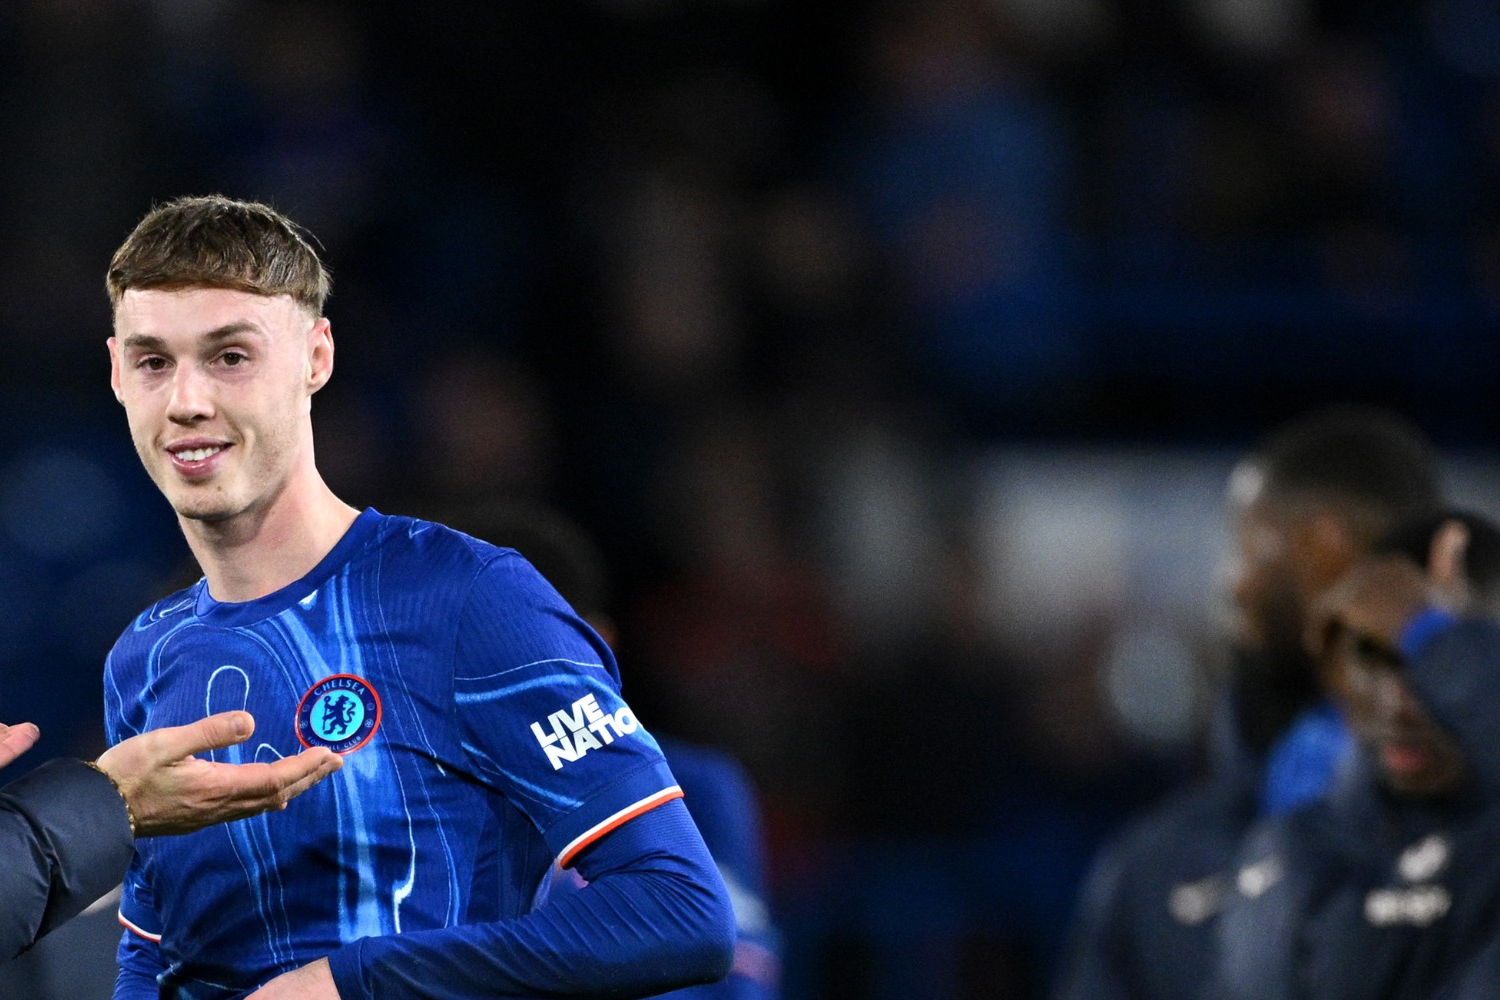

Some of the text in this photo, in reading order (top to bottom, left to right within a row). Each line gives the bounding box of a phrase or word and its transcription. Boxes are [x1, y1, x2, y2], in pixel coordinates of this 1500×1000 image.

[314, 679, 366, 696] CHELSEA
[530, 692, 605, 748] LIVE
[343, 735, 362, 748] CLUB
[543, 706, 638, 771] NATIO
